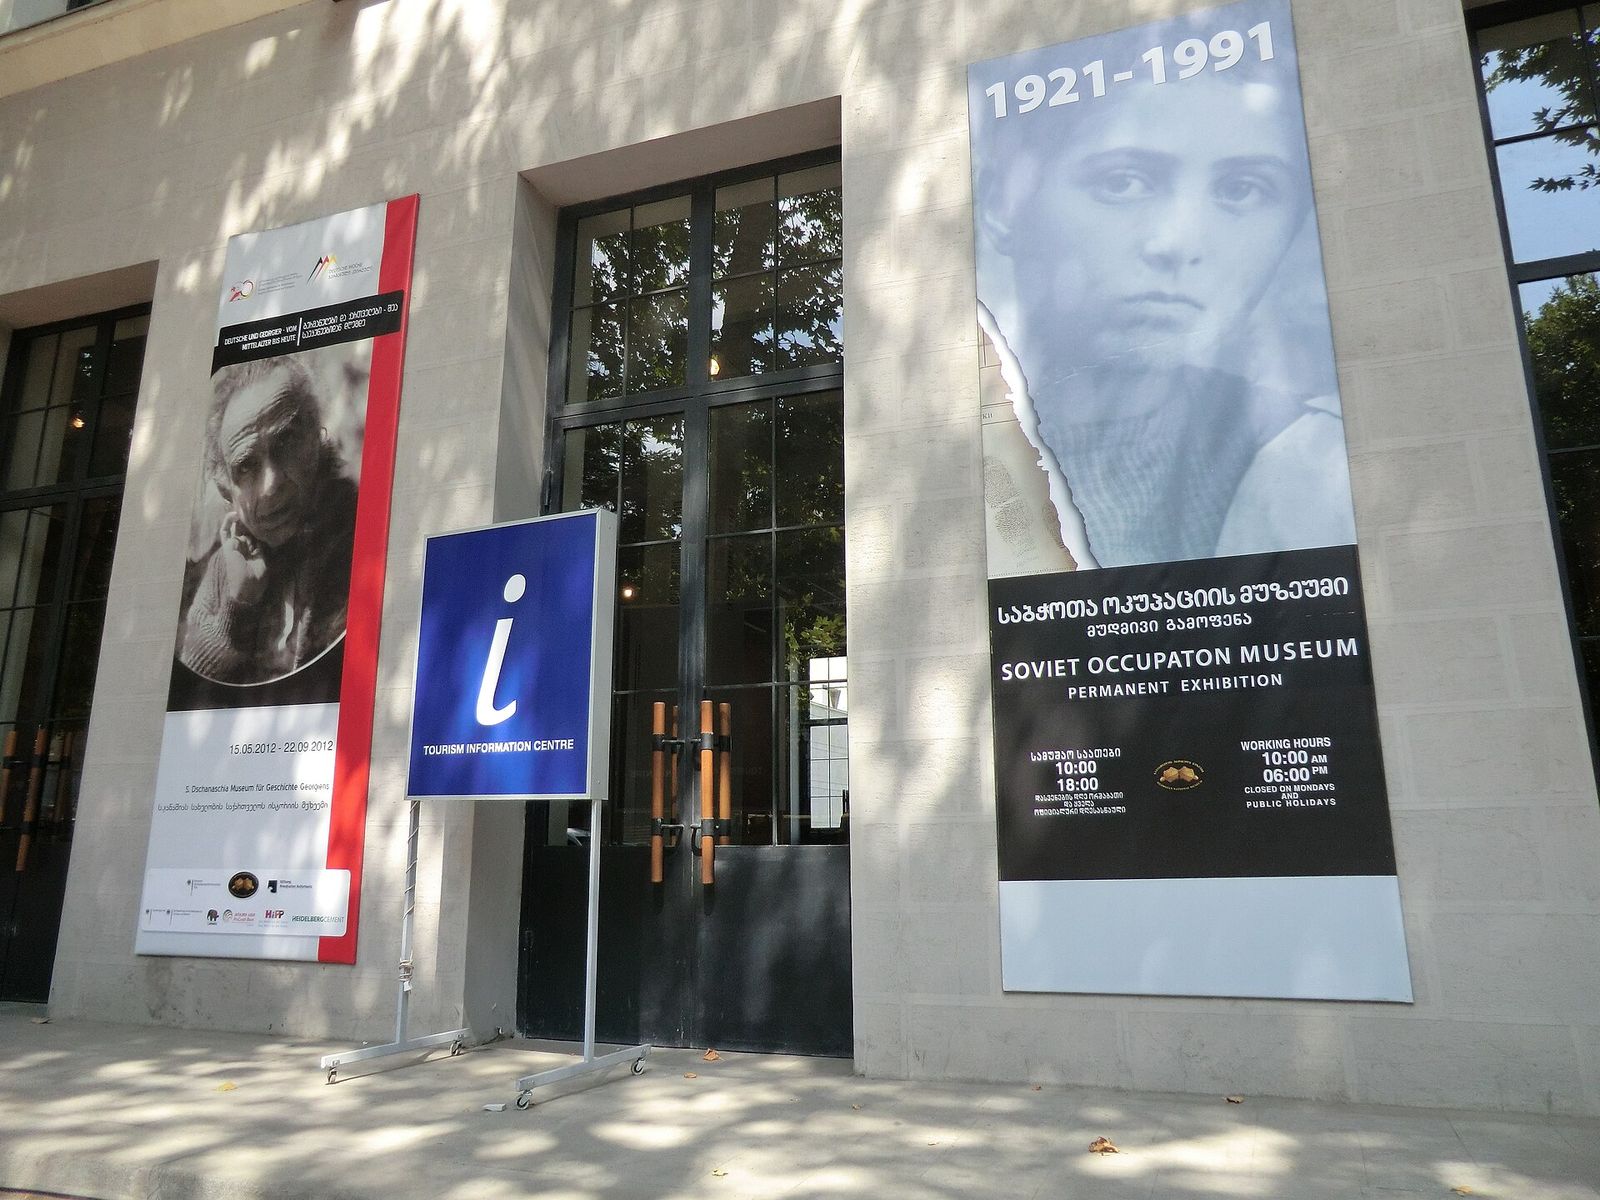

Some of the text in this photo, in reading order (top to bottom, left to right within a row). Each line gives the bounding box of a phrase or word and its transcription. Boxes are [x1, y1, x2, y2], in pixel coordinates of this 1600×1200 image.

[985, 21, 1274, 119] 1921-1991
[224, 334, 248, 345] DEUTSCHE
[248, 332, 258, 341] UND
[260, 328, 282, 339] GEORGIER
[286, 325, 297, 333] VOM
[241, 334, 296, 351] MITTELALTER BIS HEUTE
[998, 577, 1348, 624] საბჭოთა ოკუპაციის მუზეუმი
[1087, 612, 1252, 637] მუდმივი გამოფენა
[1001, 638, 1359, 681] SOVIET OCCUPATON MUSEUM
[1068, 673, 1283, 699] PERMANENT EXHIBITION
[230, 743, 276, 755] 15.05.2012
[284, 740, 333, 753] 22.09.2012
[423, 738, 574, 756] TOURISM INFORMATION CENTRE
[1241, 737, 1331, 751] WORKING HOURS
[1030, 747, 1121, 762] სამუშაო საათები
[1262, 750, 1327, 766] 10:00 AM
[1055, 761, 1097, 775] 10:00
[1263, 766, 1328, 783] 06:00 PM
[230, 784, 254, 793] Museum
[256, 783, 265, 792] für
[265, 783, 298, 792] Geschichte
[300, 782, 329, 793] Georgiens
[1057, 777, 1099, 792] 18:00
[1293, 783, 1335, 792] MONDAYS
[1281, 792, 1299, 800] AND
[1286, 798, 1336, 807] HOLIDAYS
